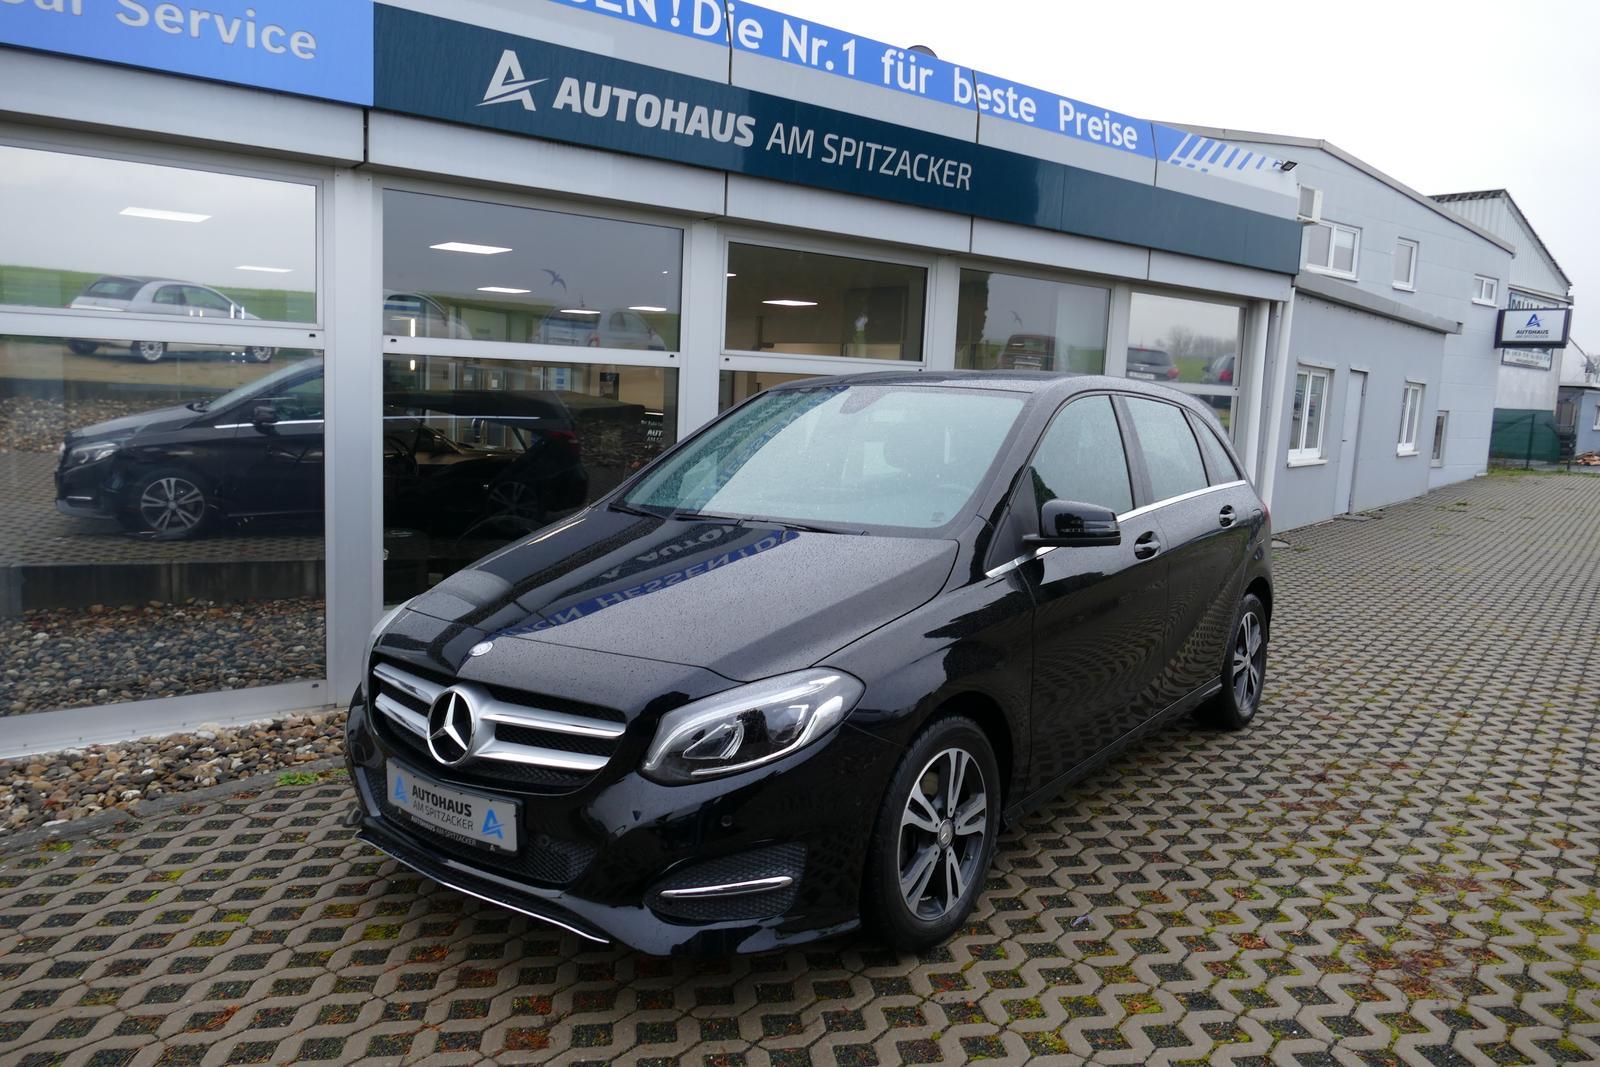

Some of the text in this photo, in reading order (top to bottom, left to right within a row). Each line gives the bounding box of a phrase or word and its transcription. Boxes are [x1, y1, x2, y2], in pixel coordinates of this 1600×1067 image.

[115, 0, 318, 60] Service
[781, 21, 857, 76] Nr.1
[881, 49, 934, 94] für
[953, 67, 1037, 123] beste
[1058, 100, 1139, 151] Preise
[552, 76, 973, 191] AUTOHAUS AM SPITZACKER
[411, 784, 473, 818] AUTOHAUS
[413, 800, 474, 831] AM SPITZACKER
